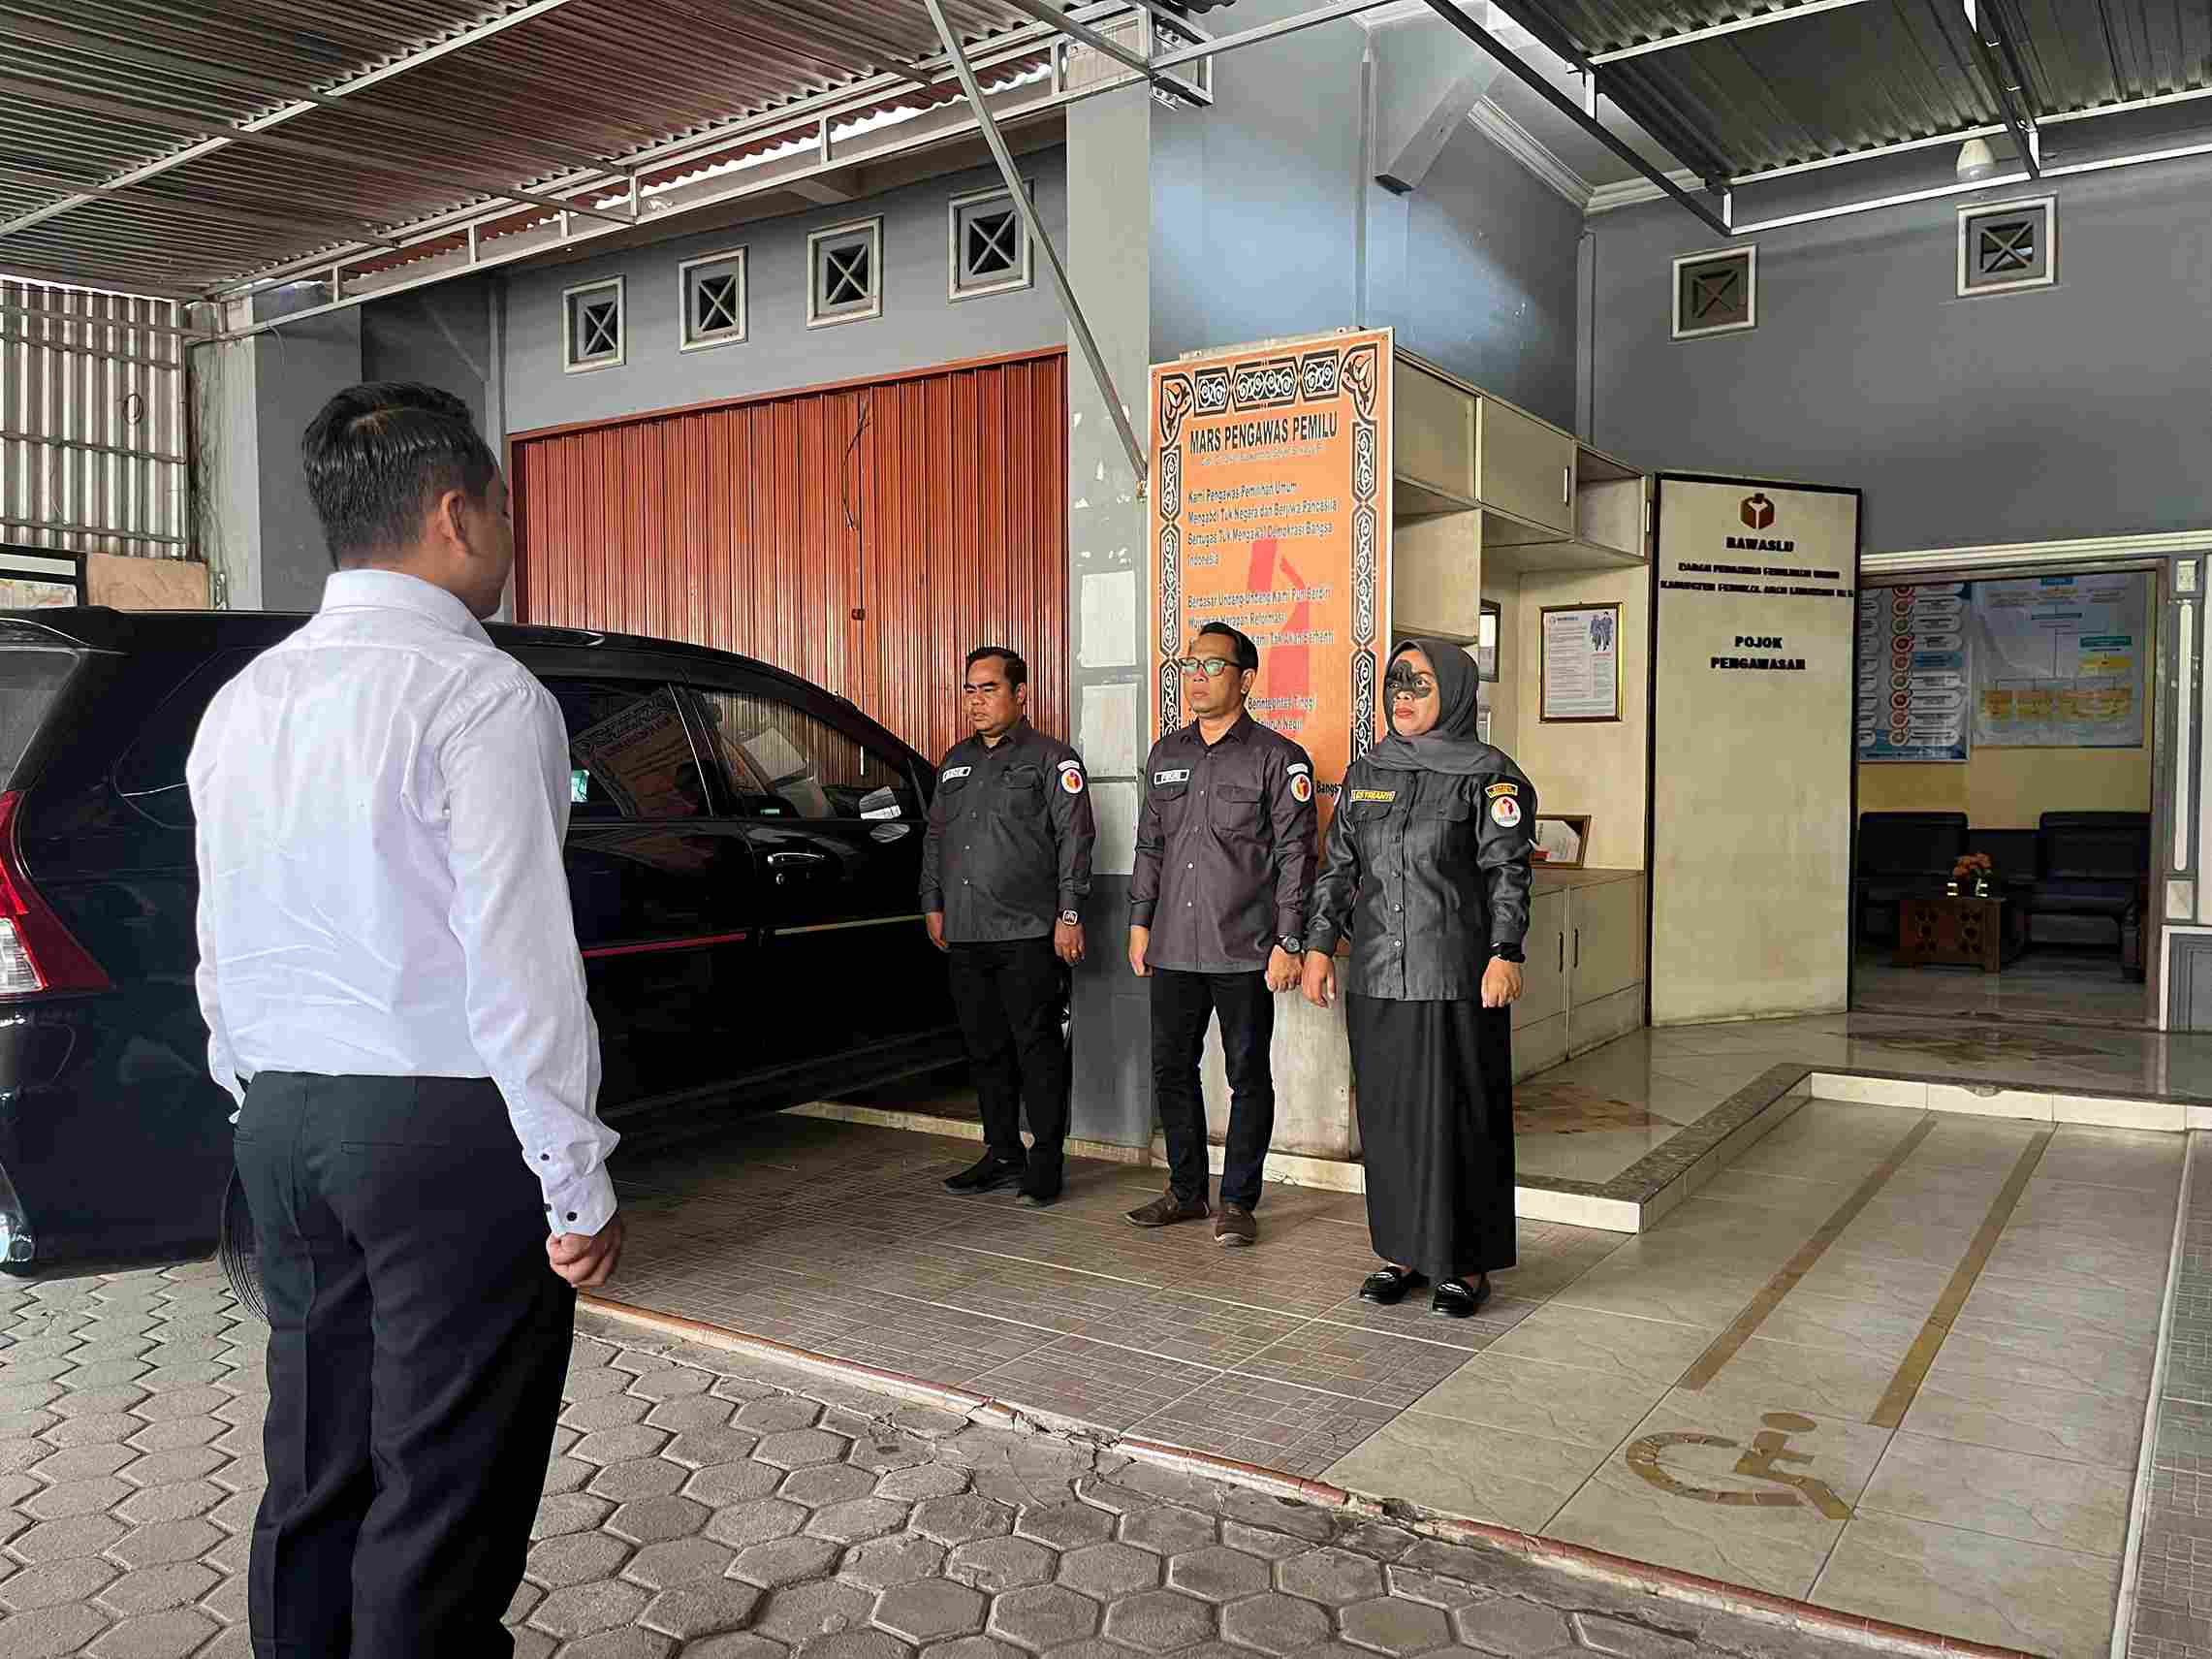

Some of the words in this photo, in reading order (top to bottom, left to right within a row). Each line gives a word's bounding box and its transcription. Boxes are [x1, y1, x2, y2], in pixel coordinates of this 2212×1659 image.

[1189, 427, 1221, 454] MARS
[1224, 419, 1288, 450] PENGAWAS
[1292, 411, 1338, 440] PEMILU
[1726, 536, 1794, 552] BAWASLU
[1735, 636, 1784, 649] POJOK
[1711, 656, 1806, 670] PENGAWASAN
